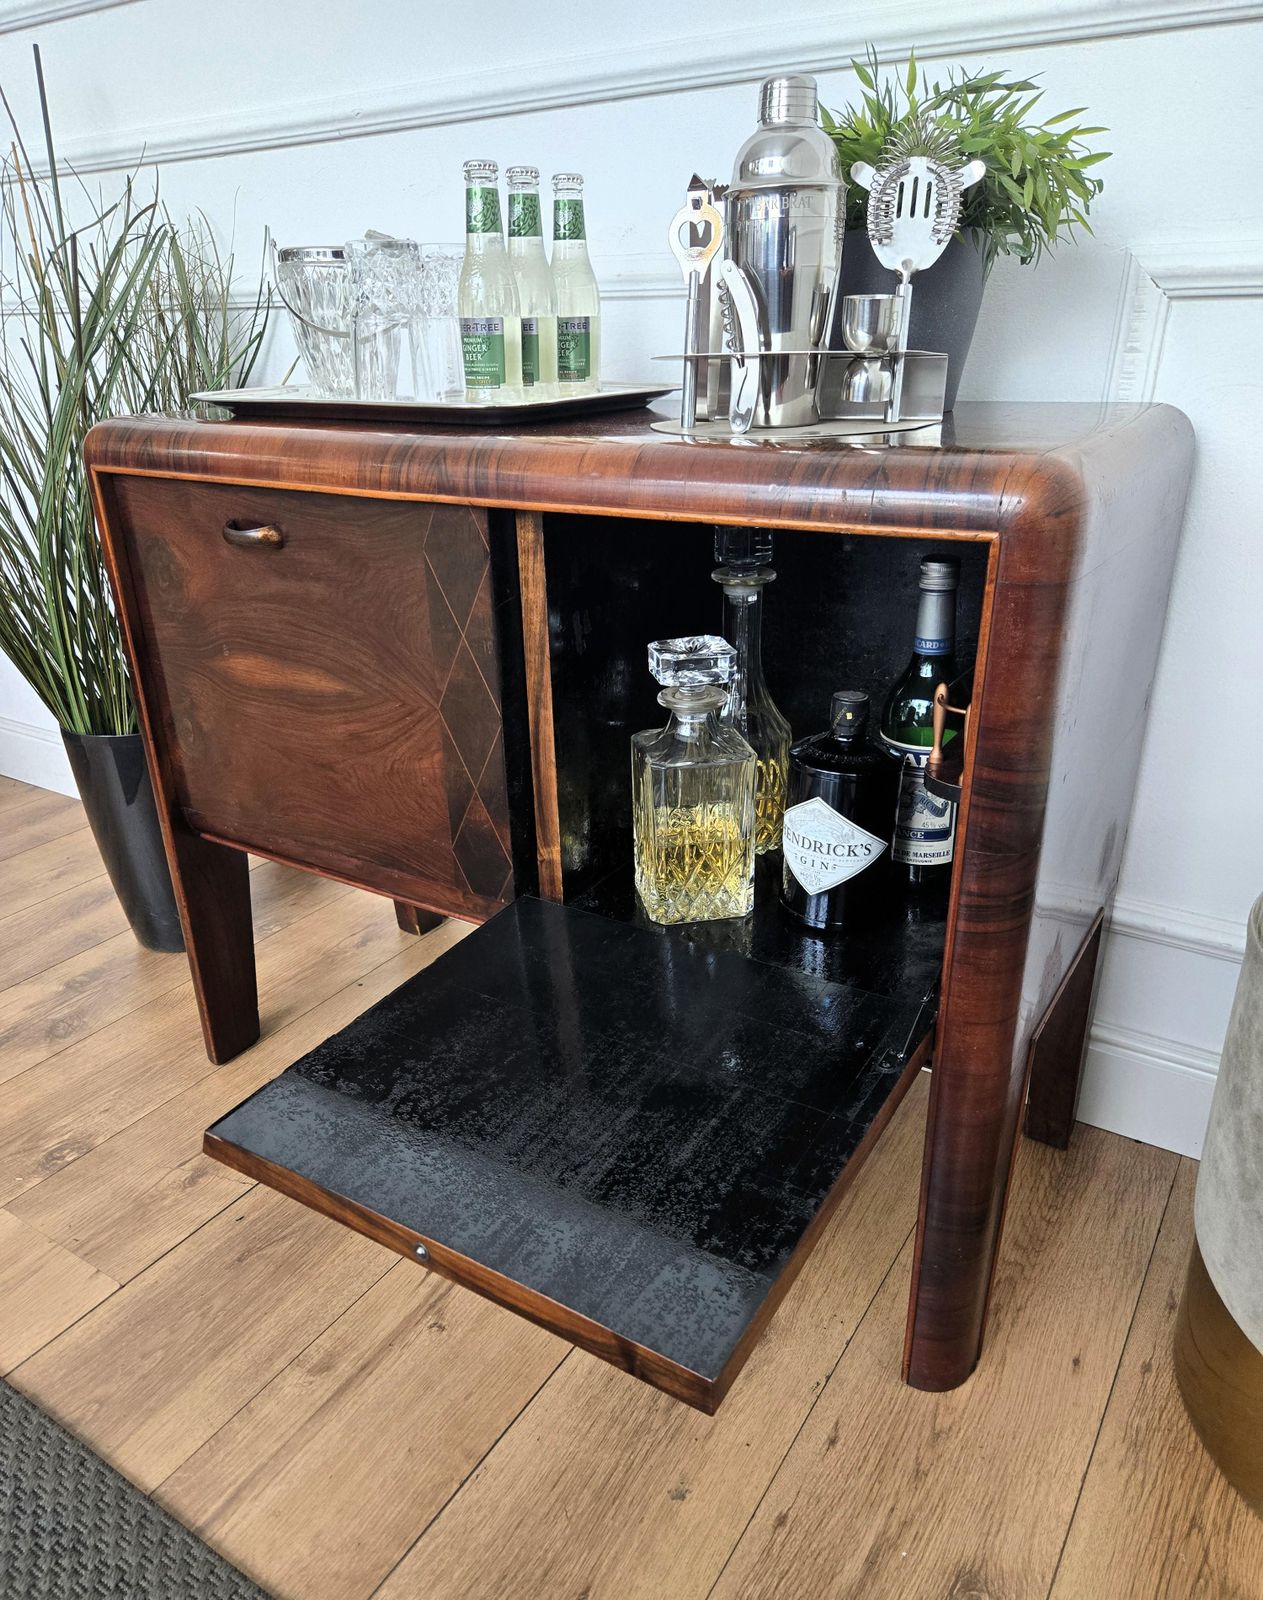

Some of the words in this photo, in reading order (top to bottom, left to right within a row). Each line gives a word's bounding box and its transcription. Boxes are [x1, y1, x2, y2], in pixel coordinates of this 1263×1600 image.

[781, 196, 814, 209] BRAT
[465, 353, 483, 362] BEER
[912, 849, 951, 859] MARSEILLE
[799, 854, 830, 871] GIN
